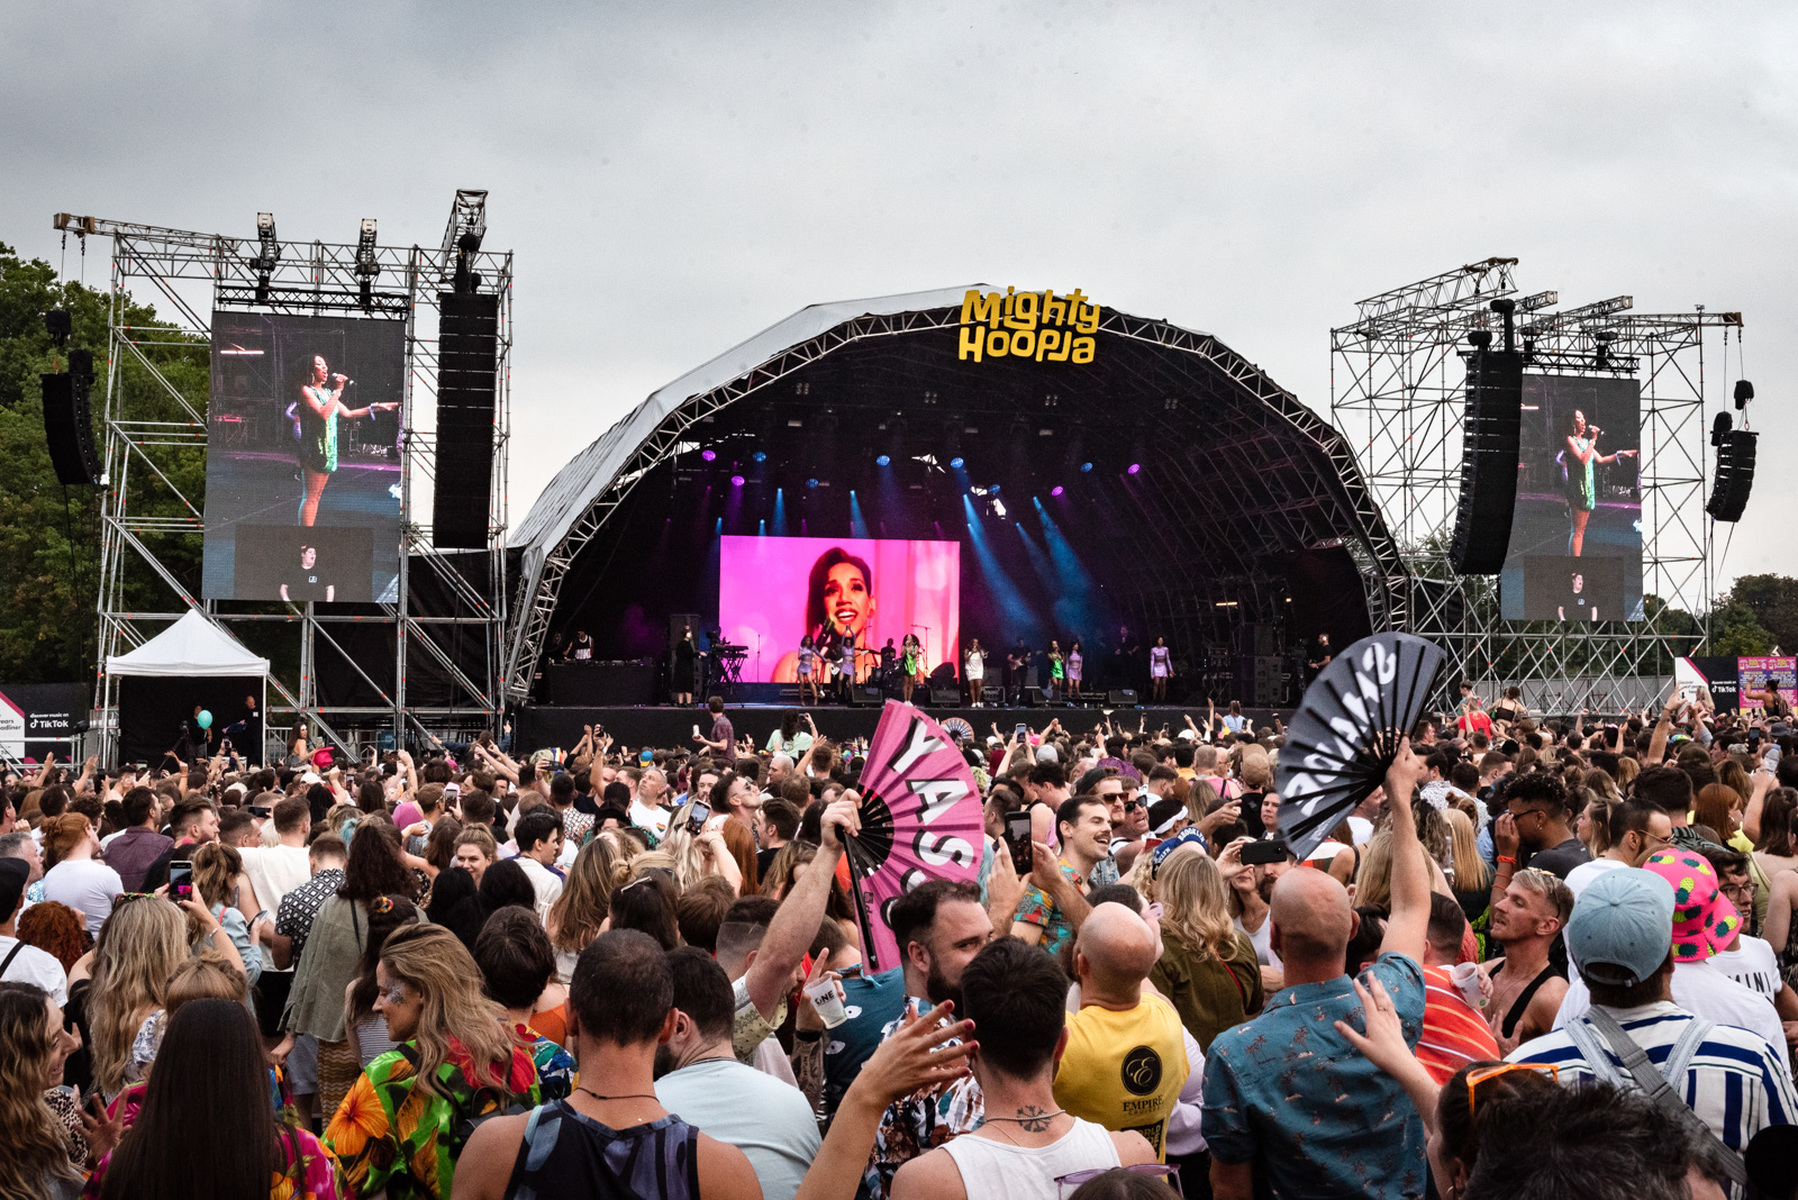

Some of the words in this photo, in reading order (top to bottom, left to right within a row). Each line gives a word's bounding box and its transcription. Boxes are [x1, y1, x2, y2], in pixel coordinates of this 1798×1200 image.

[960, 285, 1100, 334] Mighty
[958, 326, 1096, 364] Hoopla
[40, 720, 69, 728] TikTok
[1122, 1095, 1164, 1111] EMPIRE
